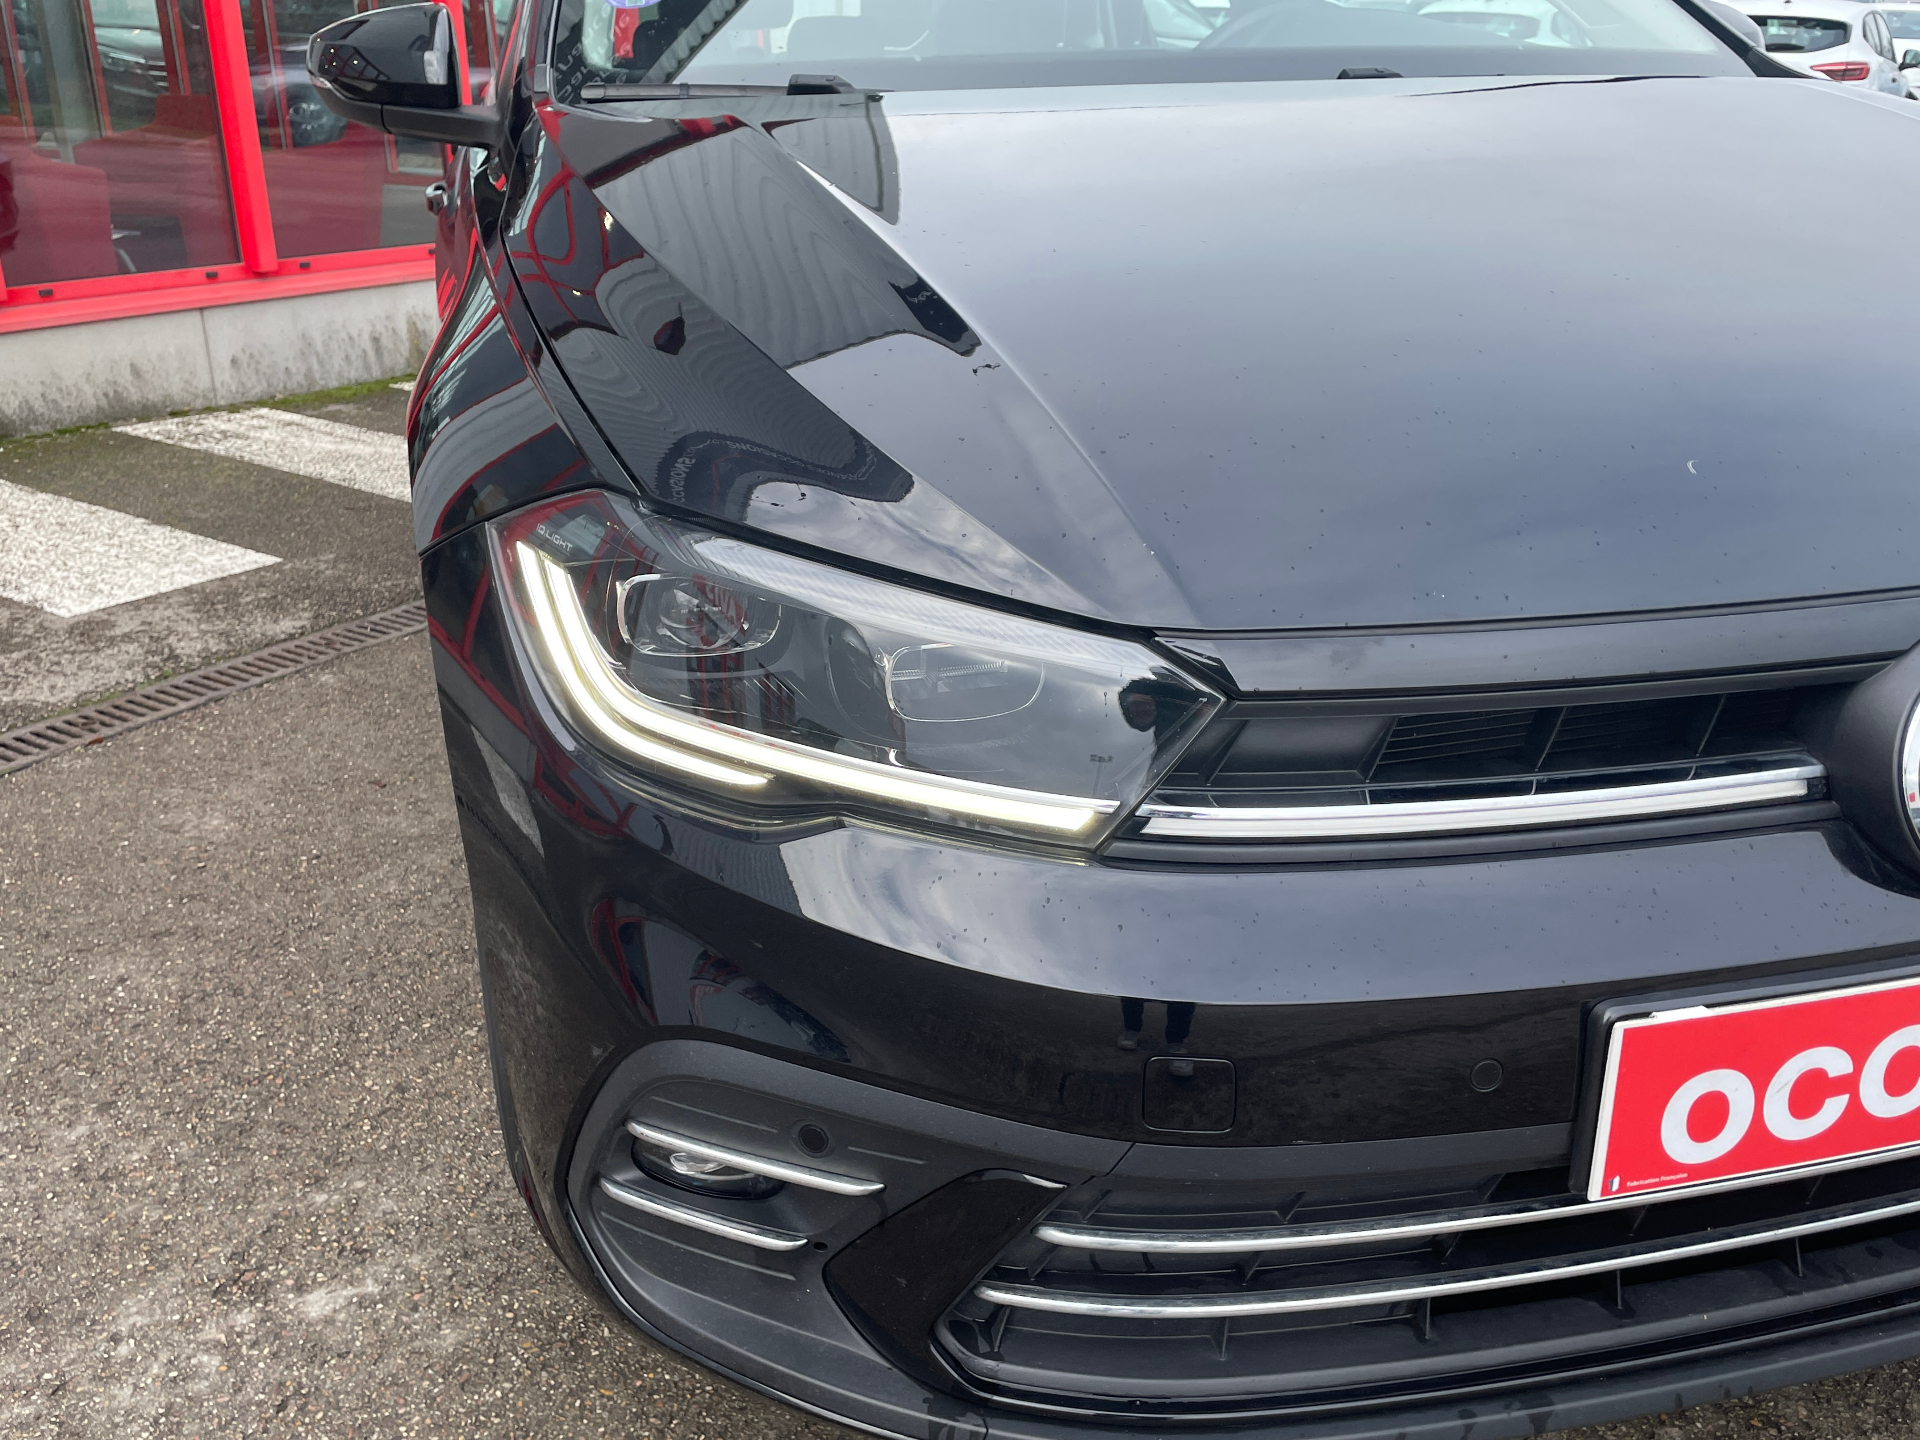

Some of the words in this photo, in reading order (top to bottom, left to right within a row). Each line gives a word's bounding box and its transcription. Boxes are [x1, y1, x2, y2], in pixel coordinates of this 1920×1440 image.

[536, 522, 573, 552] IQ.LIGHT
[1626, 1178, 1660, 1187] Fabrication
[1660, 1172, 1688, 1182] Française
